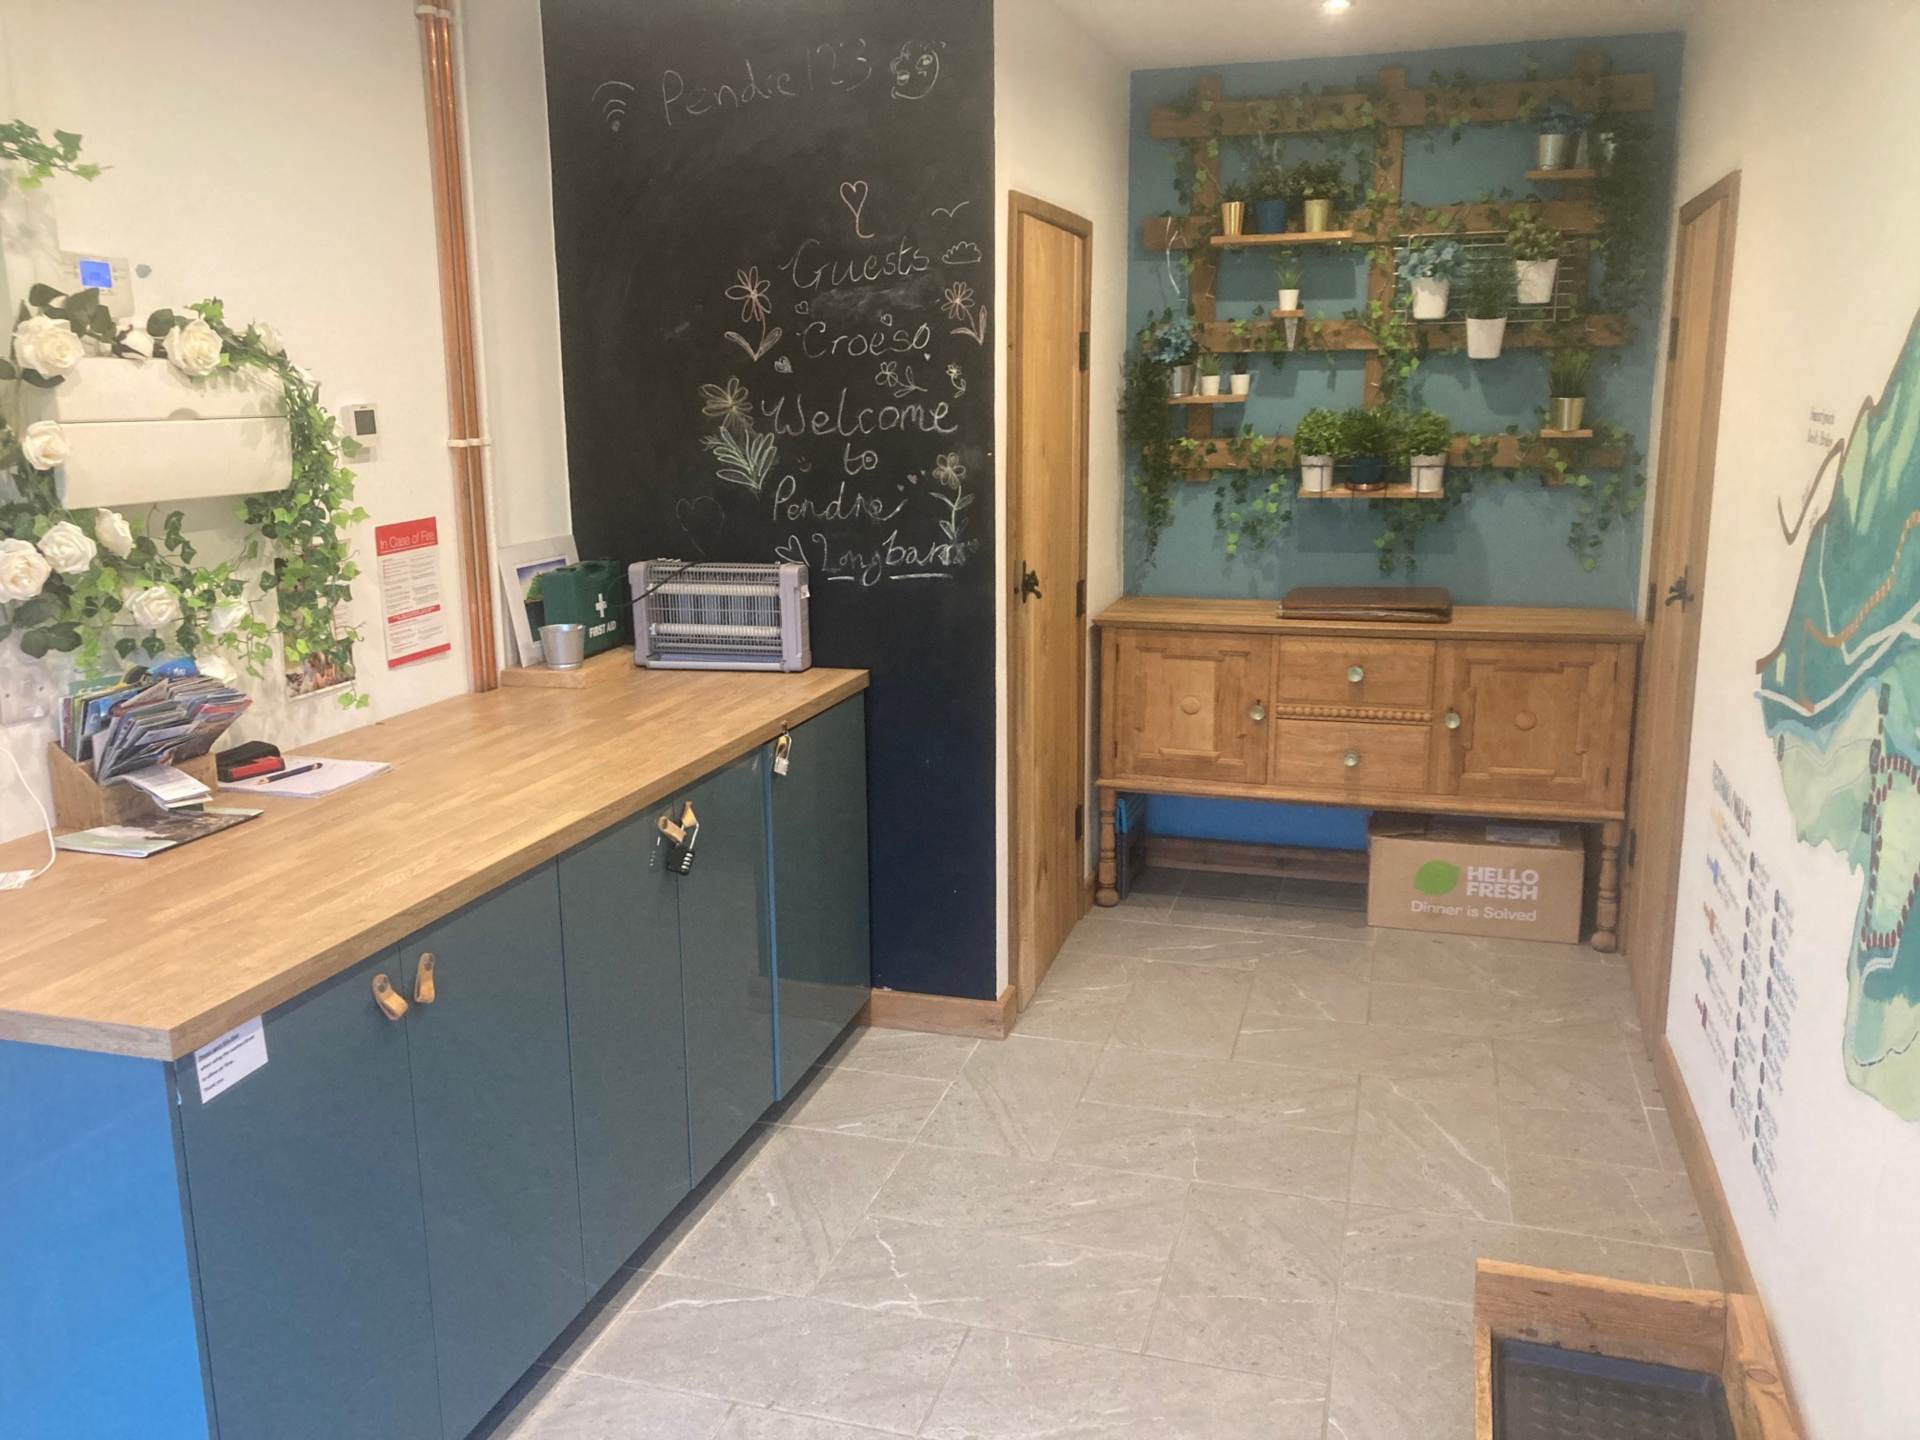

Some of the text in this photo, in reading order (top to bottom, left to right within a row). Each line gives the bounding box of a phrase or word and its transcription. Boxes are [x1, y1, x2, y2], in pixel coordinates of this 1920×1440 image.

[779, 238, 930, 289] Guests
[803, 321, 931, 358] Croeso
[761, 388, 958, 437] Welcome
[843, 443, 878, 476] to
[389, 534, 411, 548] Case
[411, 530, 420, 545] of
[420, 529, 435, 543] Fire
[589, 620, 617, 639] FIRST AID
[1467, 865, 1539, 886] HELLO
[1466, 882, 1538, 901] FRESH
[1410, 899, 1537, 922] Dinner is Solved
